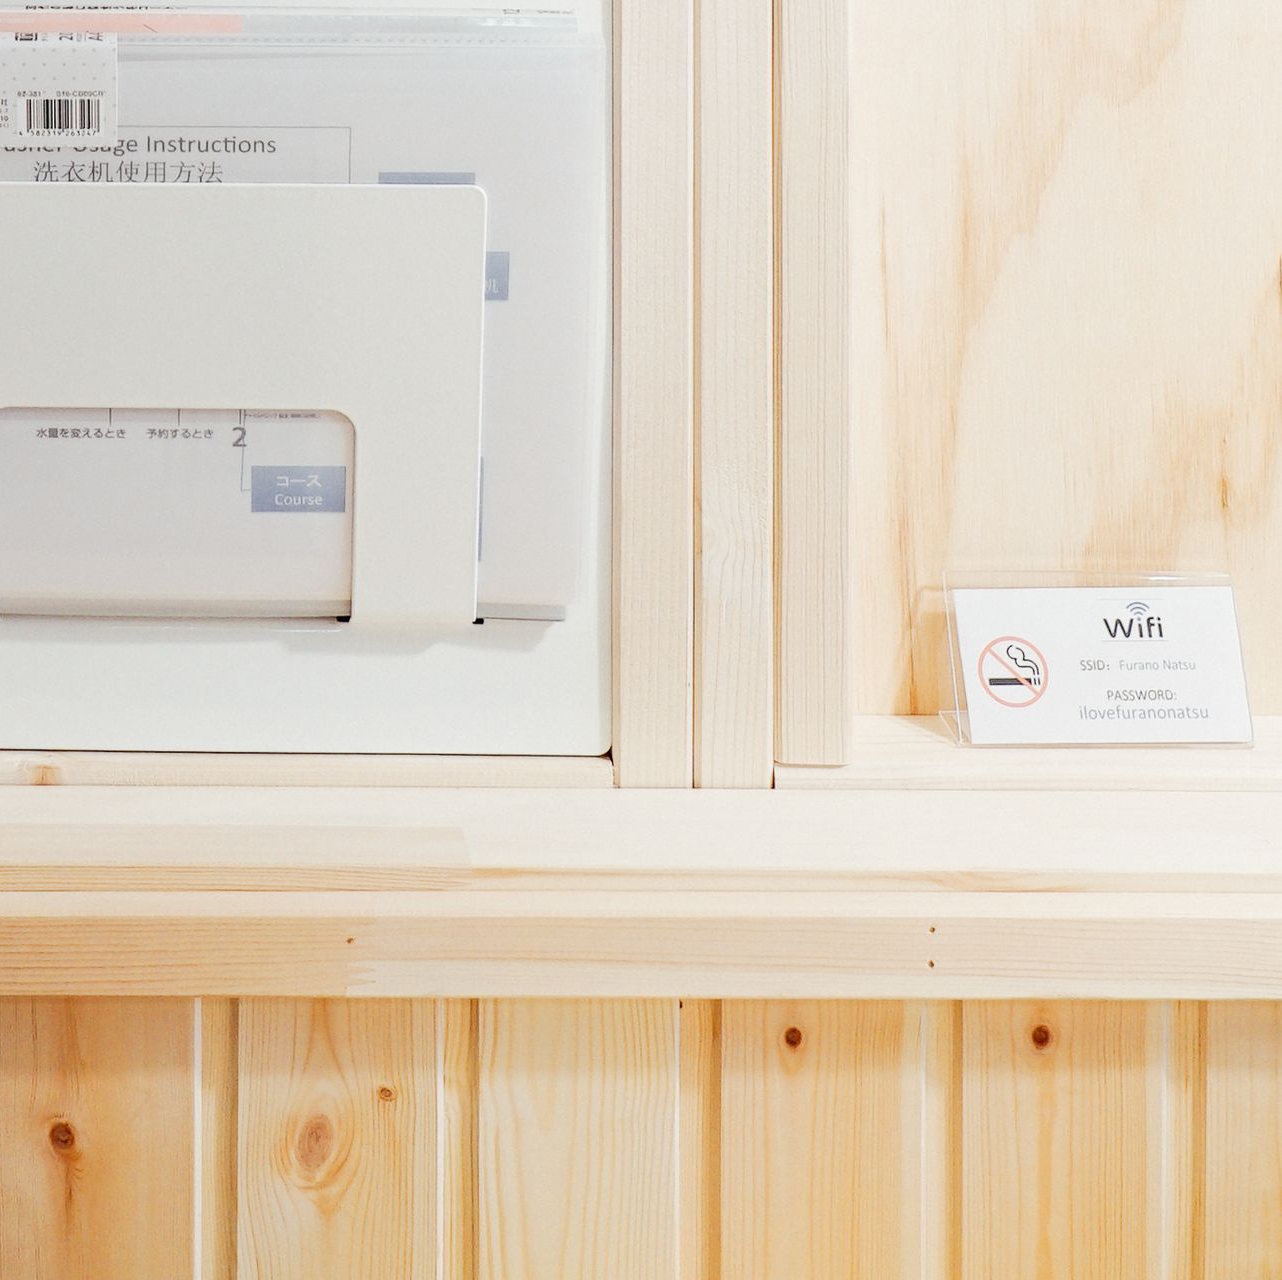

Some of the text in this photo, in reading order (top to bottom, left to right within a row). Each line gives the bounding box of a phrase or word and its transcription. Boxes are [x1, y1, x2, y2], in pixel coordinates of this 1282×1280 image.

[146, 135, 277, 154] Instructions
[33, 160, 225, 184] 洗衣机使用方法
[35, 427, 215, 440] 水量を変えるとき 予約するとき
[231, 426, 248, 448] 2
[275, 474, 323, 488] コース
[274, 493, 324, 507] Course
[1102, 616, 1164, 639] Wifi
[1079, 659, 1197, 671] SSID: Furano Natsu
[1106, 689, 1178, 702] PASSWORD:
[1078, 705, 1210, 720] ilovefuranonatsu
